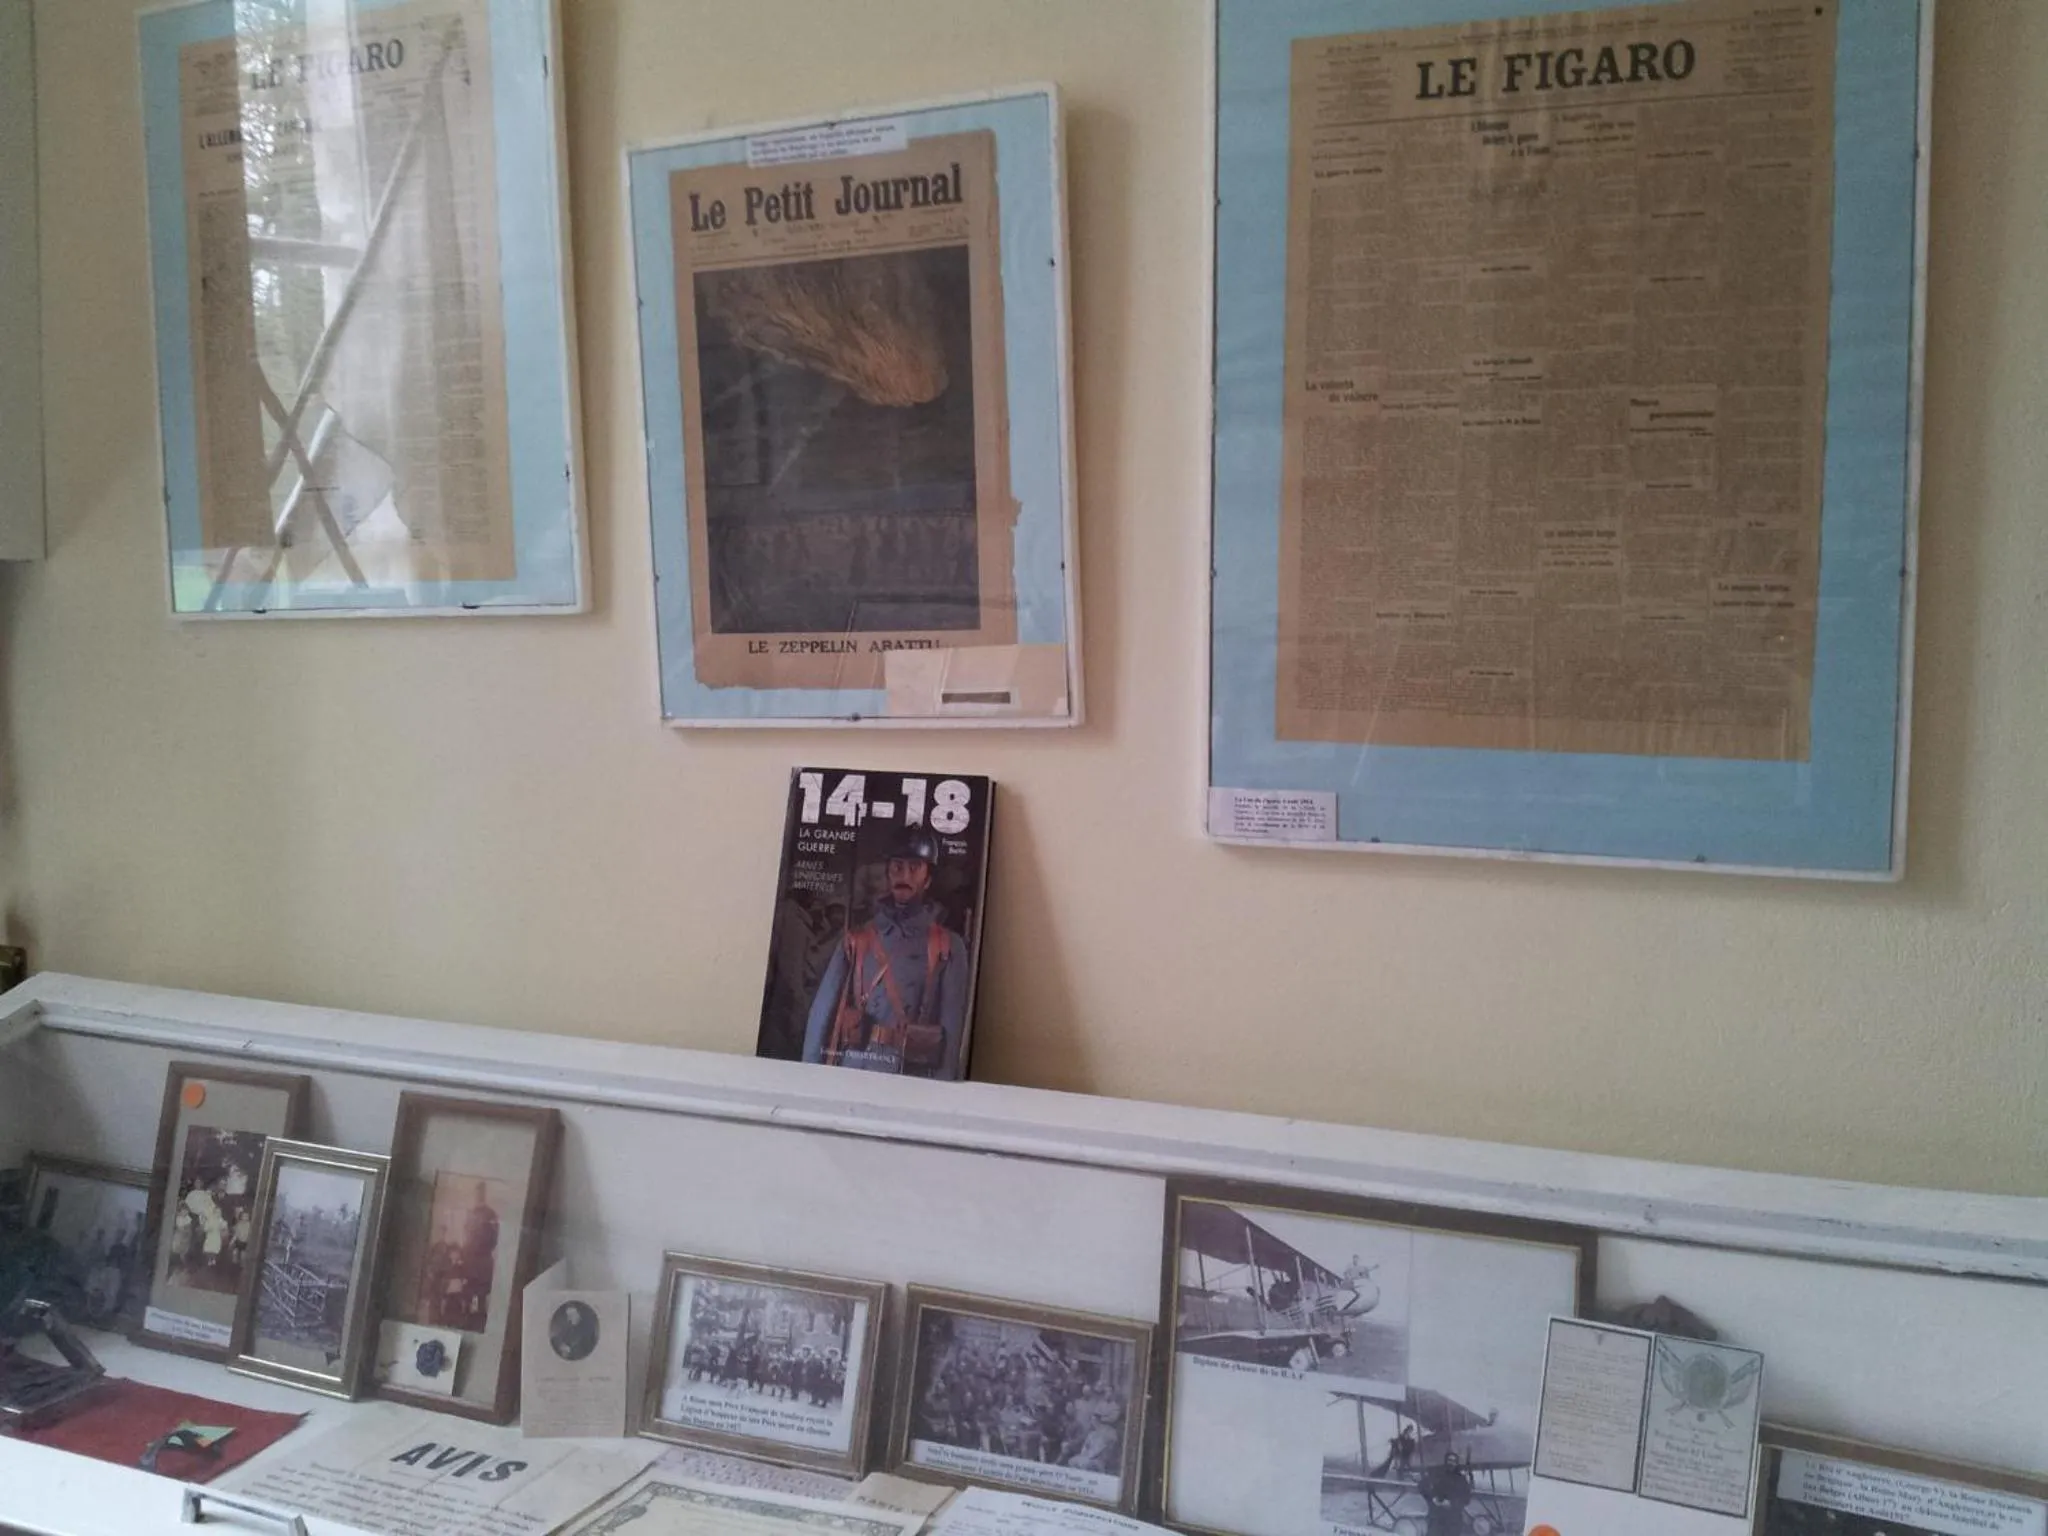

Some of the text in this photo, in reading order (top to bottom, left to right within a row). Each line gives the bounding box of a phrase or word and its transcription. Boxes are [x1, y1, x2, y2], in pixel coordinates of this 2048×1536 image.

[298, 38, 405, 83] FIGARO
[1415, 57, 1477, 100] LE
[1502, 39, 1695, 92] FIGARO
[688, 162, 963, 232] Le Petit Journal
[748, 640, 769, 654] LE
[779, 640, 858, 654] ZEPPELIN
[798, 771, 971, 834] 14-18
[797, 841, 836, 854] GUERRE
[799, 827, 857, 842] LA GRANDE
[389, 1441, 528, 1483] AVIS
